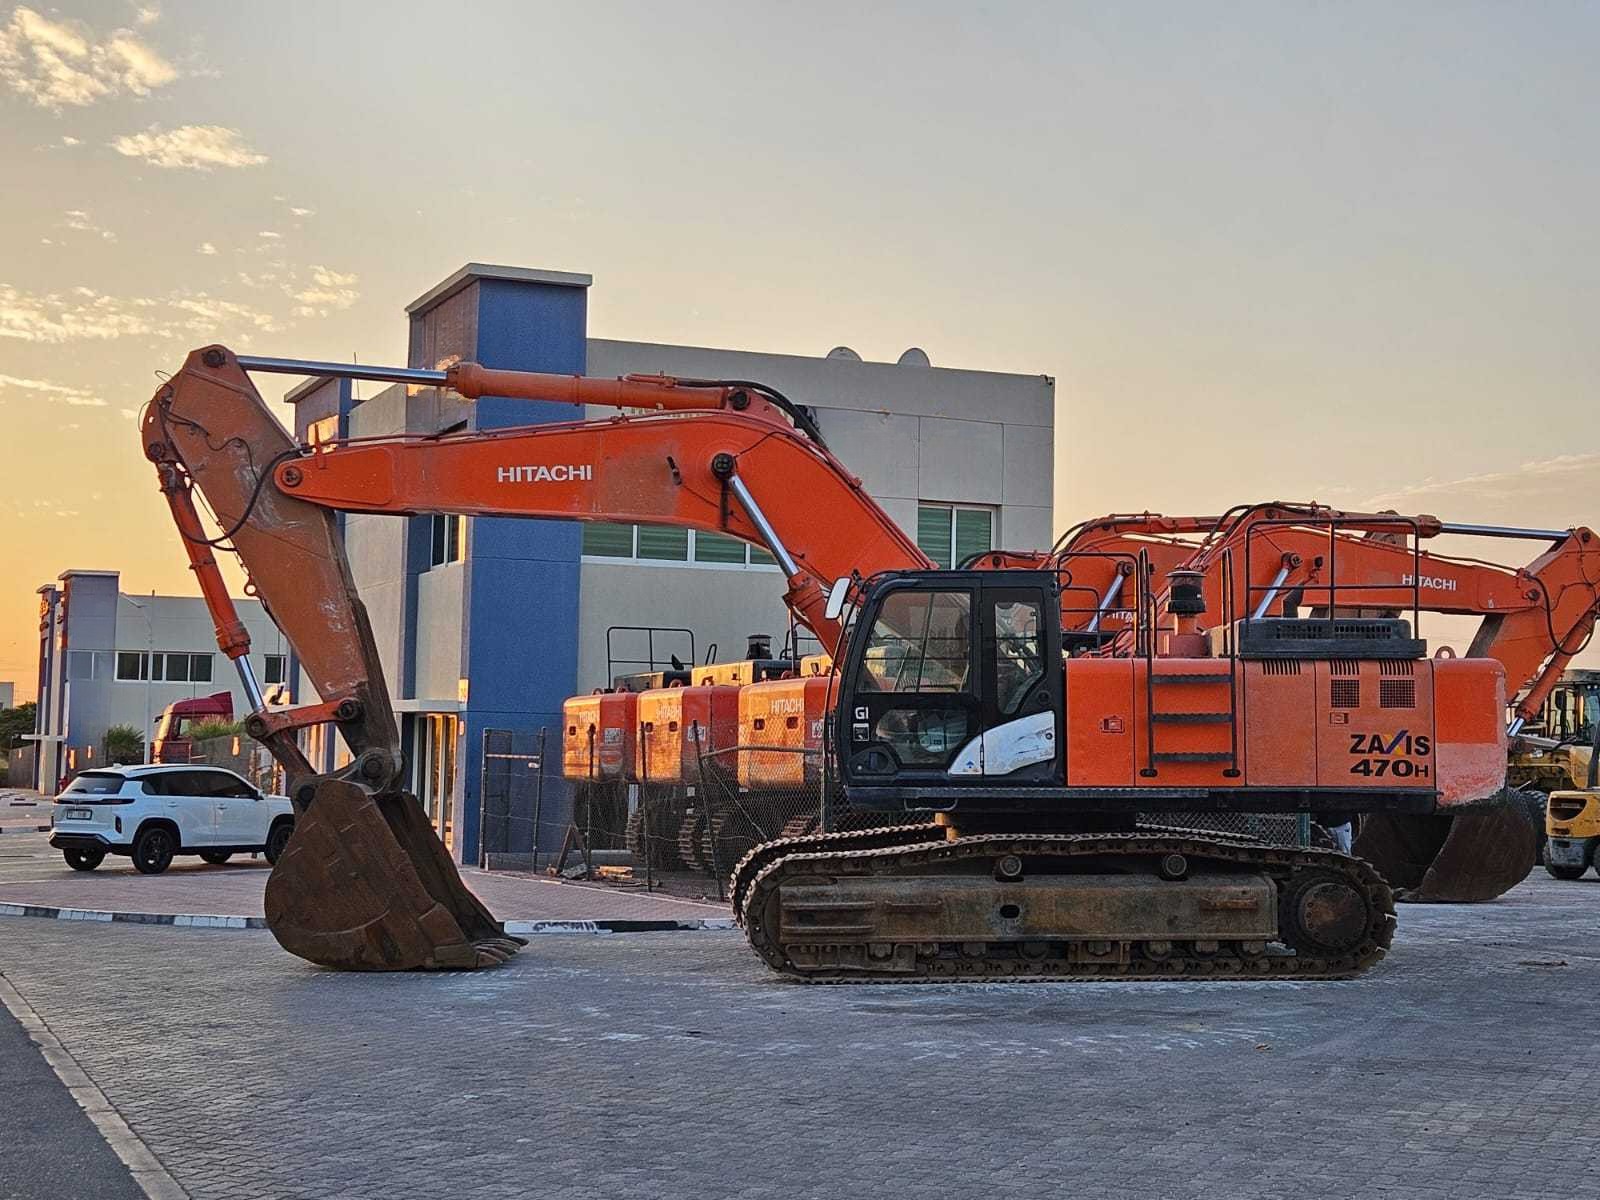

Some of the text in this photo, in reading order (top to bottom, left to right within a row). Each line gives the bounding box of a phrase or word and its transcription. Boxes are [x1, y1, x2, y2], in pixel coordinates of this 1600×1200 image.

[497, 465, 593, 482] HITACHI
[1402, 574, 1457, 591] HITACHI
[1350, 730, 1431, 756] ZAXIS
[1350, 759, 1429, 778] 470H
